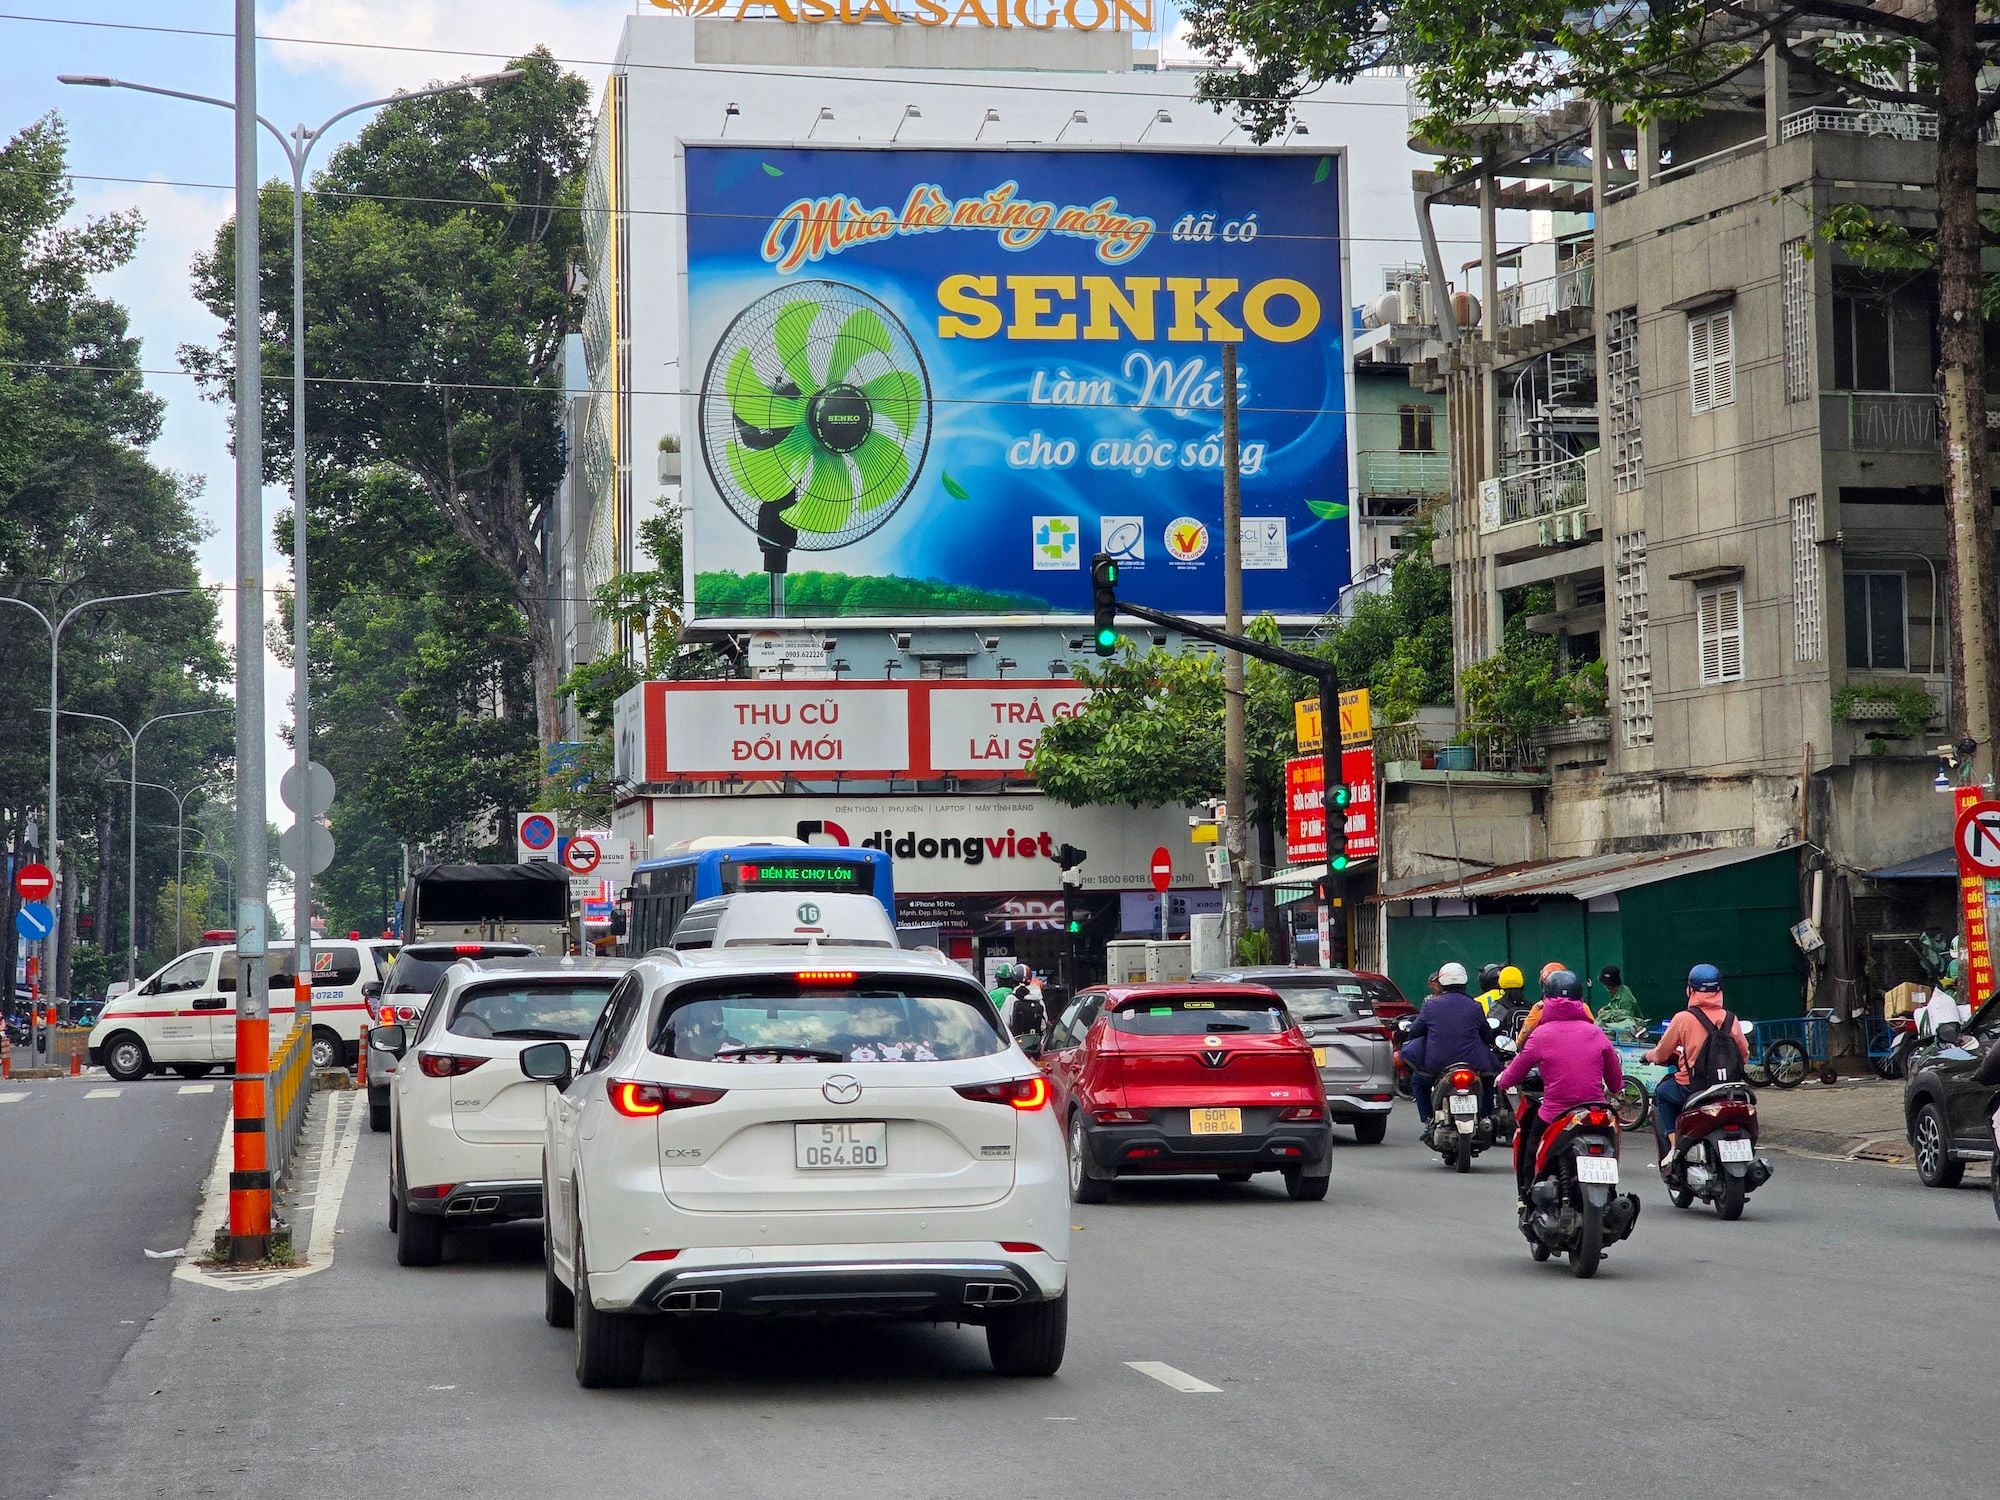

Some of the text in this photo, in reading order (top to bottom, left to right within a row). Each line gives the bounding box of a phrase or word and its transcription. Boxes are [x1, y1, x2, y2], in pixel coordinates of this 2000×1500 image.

[735, 0, 1153, 32] ASIA SAIGON
[764, 183, 1152, 271] Mùa hè nắng nóng
[1172, 212, 1259, 243] đã có
[937, 274, 1321, 343] SENKO
[1031, 371, 1113, 406] Làm
[1010, 431, 1266, 477] cho cuộc sốg
[733, 699, 839, 725] THU CŨ
[991, 697, 1045, 723] TRẢ
[732, 733, 842, 761] ĐỔI MỚI
[970, 734, 1010, 760] LÃI
[835, 806, 878, 814] ĐIỆN THOẠI
[888, 805, 924, 814] PHỤ KIỆN
[935, 805, 965, 813] LAPTOP
[975, 802, 1034, 812] MÁY TÍNH BẢNG
[861, 828, 1053, 866] didongviet
[761, 866, 783, 879] BẾN
[785, 868, 799, 879] XE
[801, 868, 826, 881] CHỢ
[827, 867, 852, 880] LỚN
[1099, 875, 1121, 884] 1800
[1123, 874, 1146, 883] 6018
[800, 907, 818, 921] 16
[1717, 1068, 1728, 1081] 11
[1204, 1109, 1227, 1121] 60H
[821, 1125, 861, 1144] 51L
[1198, 1121, 1236, 1132] 188.04
[664, 1148, 702, 1157] CX-5
[806, 1146, 877, 1165] 064.80
